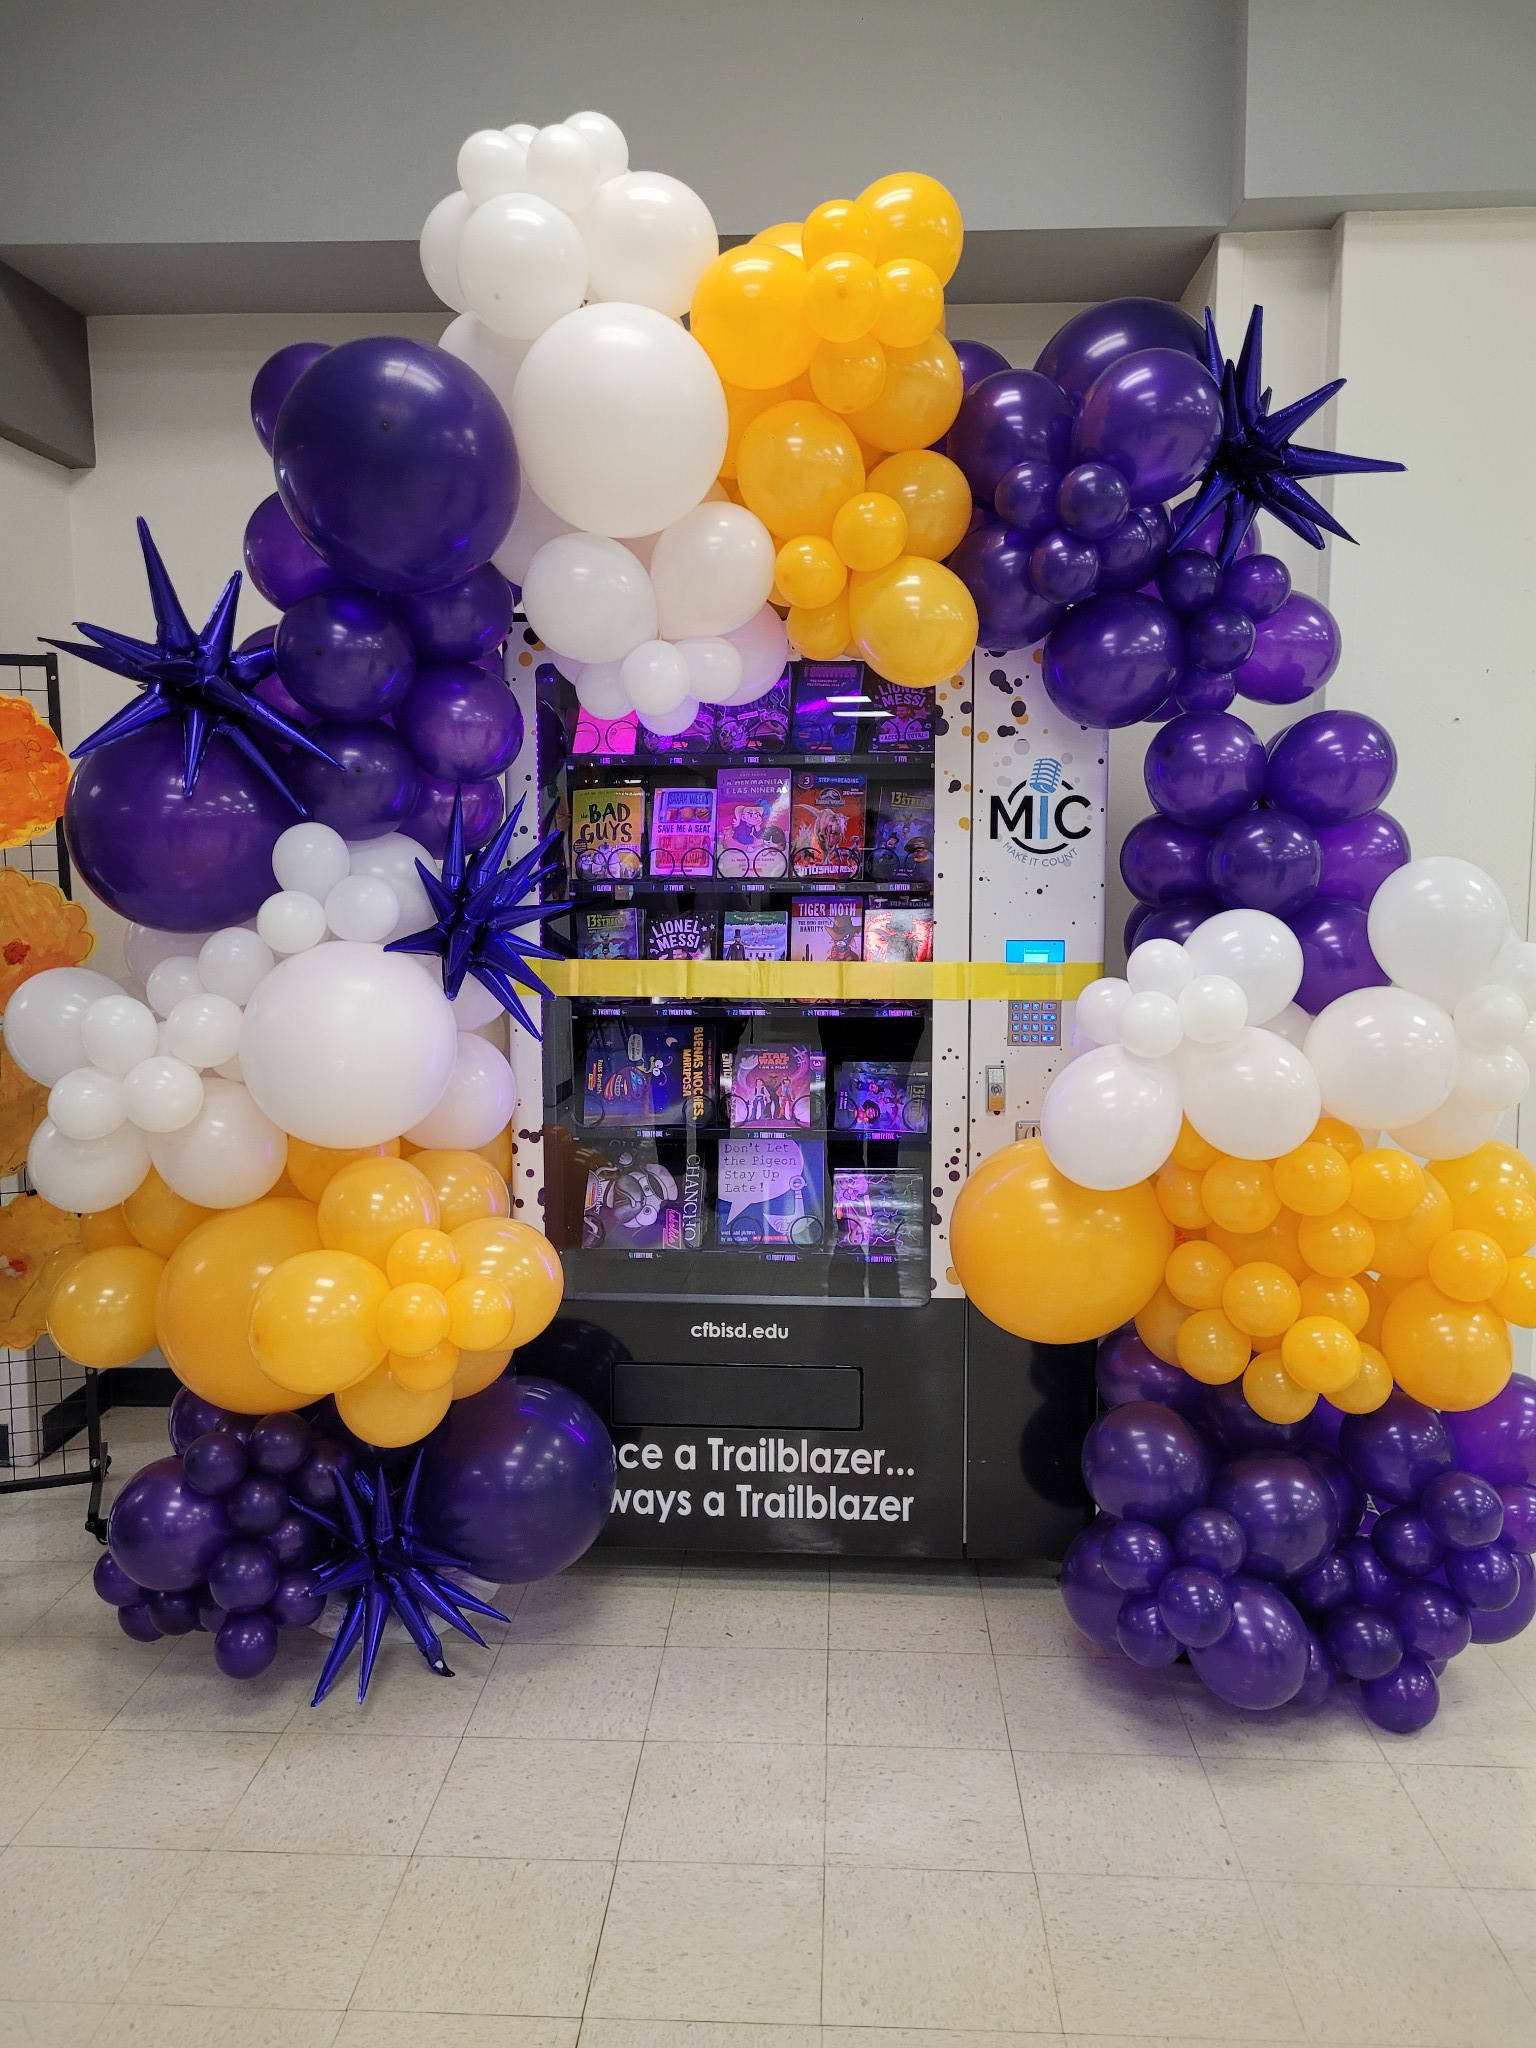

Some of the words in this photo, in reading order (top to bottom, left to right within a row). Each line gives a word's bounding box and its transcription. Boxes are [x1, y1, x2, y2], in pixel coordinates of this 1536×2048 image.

[881, 694, 926, 707] MESSI
[589, 802, 630, 824] BAD
[990, 795, 1091, 839] MIC
[580, 821, 632, 844] GUYS
[658, 825, 674, 833] SAVE
[695, 825, 710, 833] SEAT
[1002, 842, 1028, 864] MAKE
[1029, 858, 1039, 866] IT
[1041, 847, 1078, 867] COUNT
[798, 903, 826, 917] TIGER
[830, 903, 856, 916] MOTH
[651, 919, 700, 939] LIONEL
[656, 934, 700, 951] MESSI
[693, 1026, 703, 1068] BUENAS
[682, 1048, 692, 1097] MARIPOSA
[724, 1143, 759, 1153] Don't
[767, 1143, 789, 1152] Let
[724, 1156, 745, 1165] the
[752, 1156, 796, 1167] Pigeon
[724, 1170, 755, 1181] Stay
[763, 1170, 780, 1181] Up
[683, 1154, 700, 1241] CHANCHO
[725, 1183, 764, 1192] Late!
[690, 1322, 789, 1339] cfbisd.edu
[614, 1443, 663, 1470] ce
[674, 1444, 696, 1470] a
[707, 1437, 914, 1476] Trailblazer...
[610, 1489, 692, 1523] ways
[703, 1490, 725, 1517] a
[736, 1484, 914, 1522] Trailblazer
